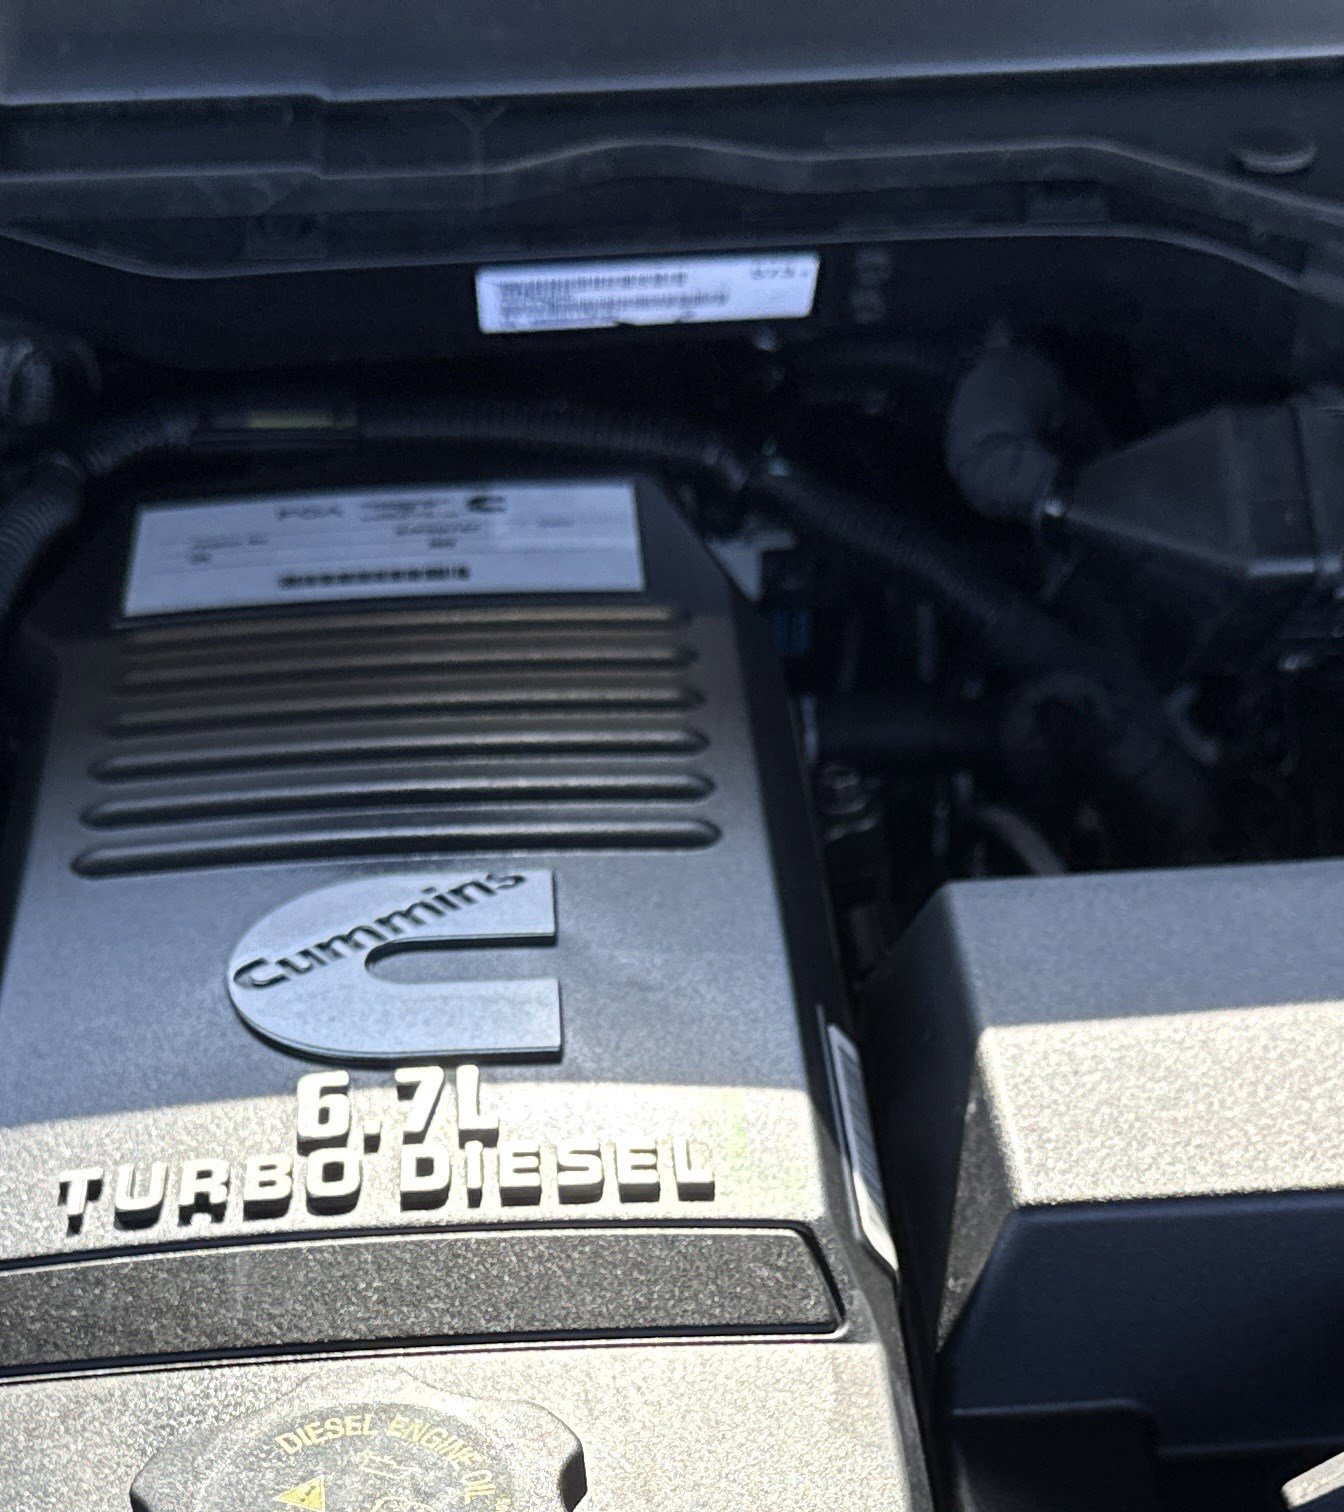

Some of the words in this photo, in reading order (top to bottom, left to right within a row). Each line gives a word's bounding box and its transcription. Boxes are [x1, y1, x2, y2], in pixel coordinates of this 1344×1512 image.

[233, 869, 527, 990] Cummins
[296, 1064, 499, 1153] 6.7L
[59, 1146, 360, 1234] TURBO
[399, 1136, 716, 1209] DIESEL
[274, 1413, 380, 1456] DIESEL
[386, 1414, 482, 1467] ENGINE
[460, 1468, 496, 1506] OIL
